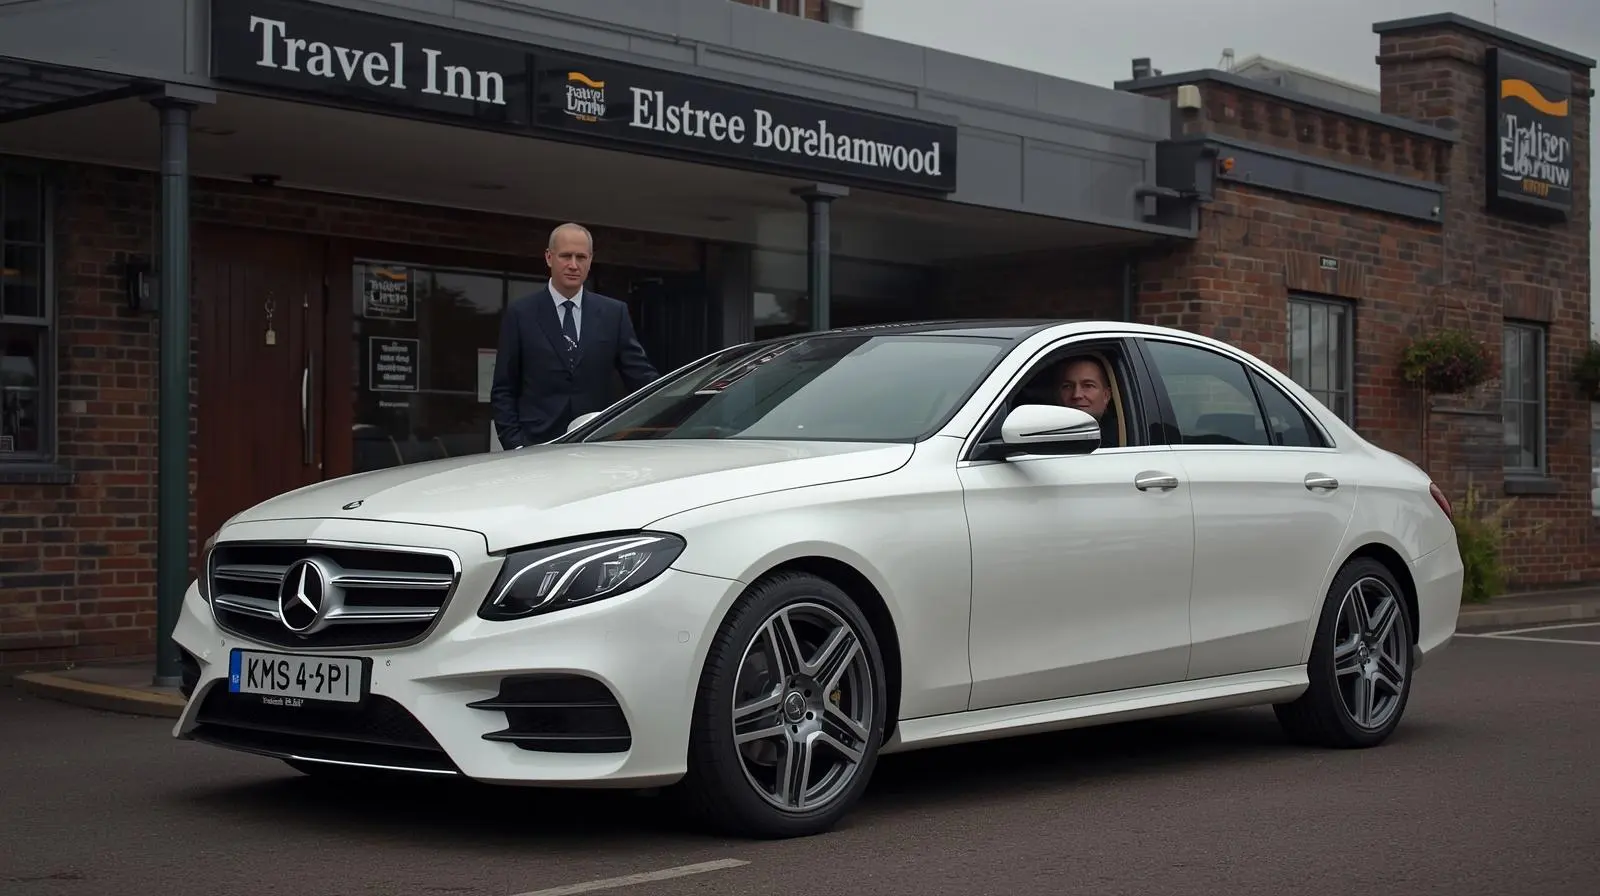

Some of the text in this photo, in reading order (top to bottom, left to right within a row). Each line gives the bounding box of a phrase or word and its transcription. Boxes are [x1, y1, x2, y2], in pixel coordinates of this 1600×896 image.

[250, 16, 505, 106] Travel Inn
[629, 87, 941, 177] Elstree Borahamwood
[247, 658, 290, 690] KMS
